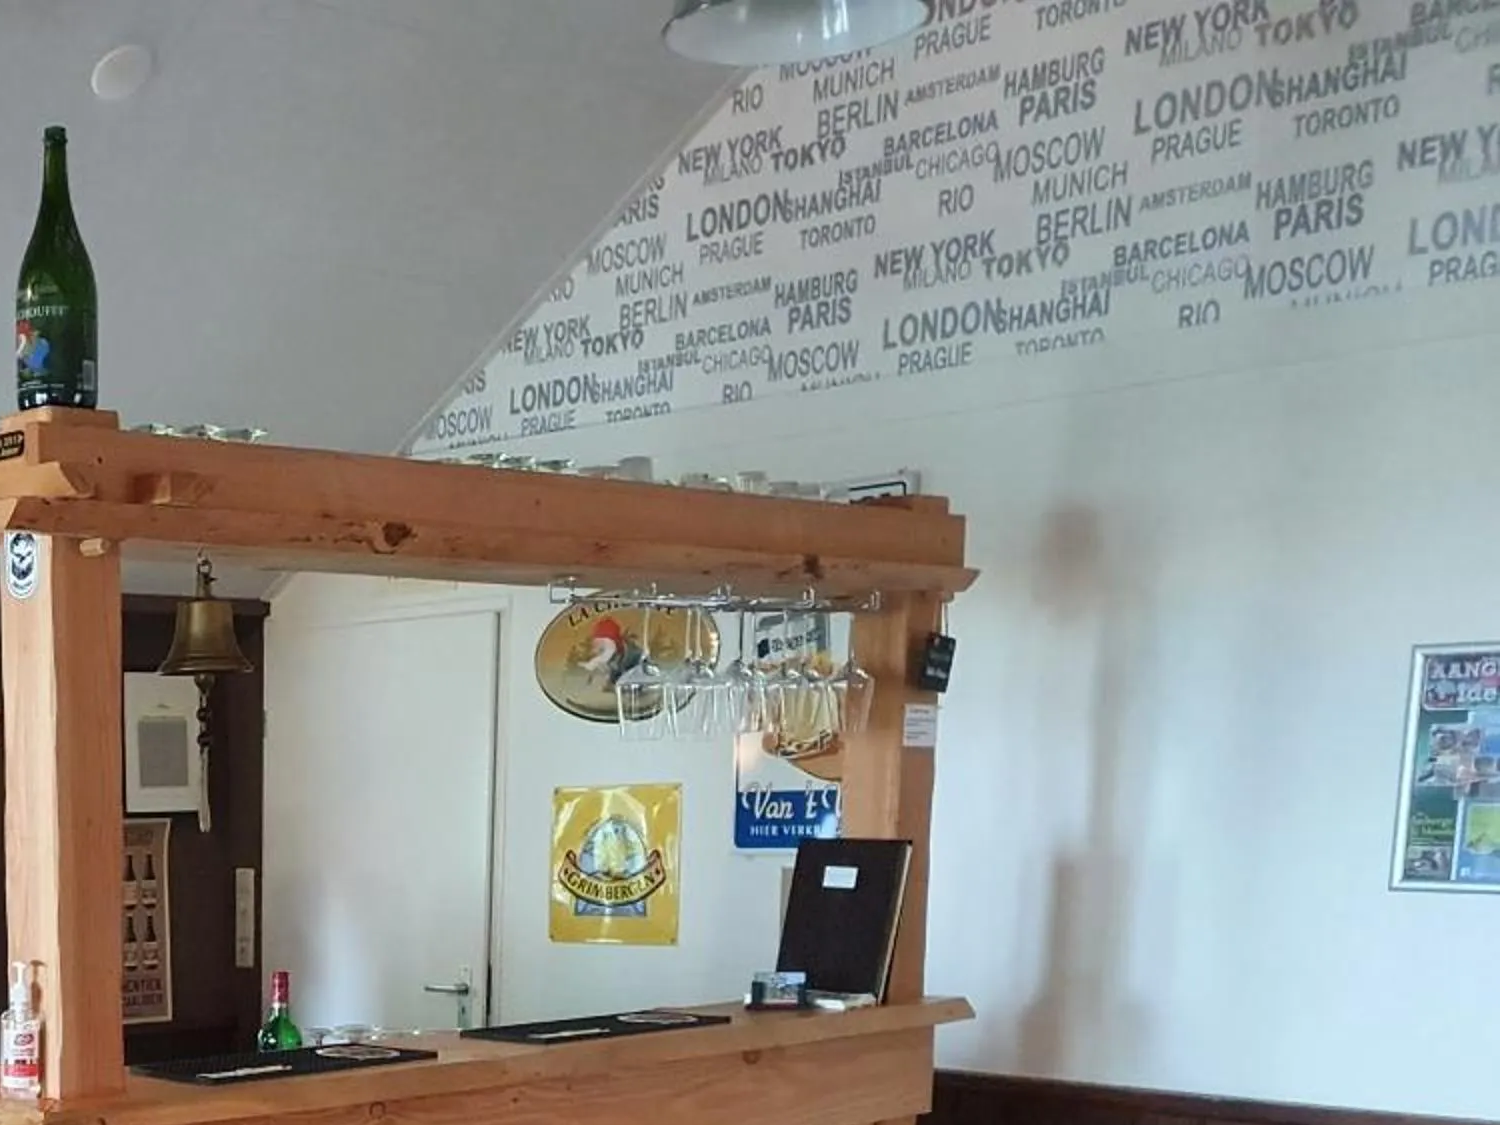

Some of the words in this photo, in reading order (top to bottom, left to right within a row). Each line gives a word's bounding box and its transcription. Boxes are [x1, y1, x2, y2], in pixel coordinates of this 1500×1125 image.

[914, 14, 992, 60] PRAGUE
[1125, 14, 1186, 56] NEW
[1194, 0, 1269, 32] YORK
[1255, 0, 1358, 47] TOKYO
[1159, 27, 1242, 67] MILANO
[813, 57, 895, 103] MUNICH
[904, 63, 1001, 106] AMSTERDAM
[1004, 46, 1104, 98] HAMBURG
[1270, 50, 1408, 108] SHANGHAI
[732, 84, 763, 115] RIO
[817, 89, 899, 138] BERLIN
[1019, 77, 1097, 127] PARIS
[1133, 67, 1280, 136] LONDON
[1293, 94, 1400, 140] TORONTO
[678, 142, 722, 175] NEW
[727, 126, 783, 158] YORK
[884, 110, 999, 157] BARCELONA
[993, 125, 1105, 183] MOSCOW
[1151, 118, 1242, 165] PRAGUE
[1397, 128, 1468, 172] NEW
[703, 155, 763, 186] MILANO
[770, 137, 847, 173] TOKYO
[916, 141, 999, 180] CHICAGO
[783, 179, 881, 223] SHANGHAI
[938, 184, 974, 218] RIO
[1033, 161, 1128, 206] MUNICH
[1139, 171, 1252, 213] AMSTERDAM
[1256, 159, 1373, 211] HAMBURG
[687, 188, 789, 242] LONDON
[799, 214, 876, 249] TORONTO
[1036, 195, 1132, 246] BERLIN
[1273, 193, 1364, 241] PARIS
[587, 232, 667, 275] MOSCOW
[700, 231, 763, 265] PRAGUE
[874, 244, 924, 279] NEW
[930, 229, 995, 264] YORK
[982, 240, 1070, 280] TOKYO
[1113, 220, 1250, 267] BARCELONA
[616, 262, 683, 297] MUNICH
[692, 277, 772, 306] AMSTERDAM
[775, 269, 858, 309] HAMBURG
[903, 259, 972, 290] MILANO
[1151, 253, 1249, 293] CHICAGO
[1244, 244, 1374, 299] MOSCOW
[544, 315, 590, 345] YORK
[620, 292, 688, 330] BERLIN
[788, 296, 852, 334] PARIS
[883, 297, 1002, 351] LONDON
[998, 288, 1111, 334] SHANGHAI
[1178, 300, 1220, 328] RIO
[580, 328, 644, 358] TOKYO
[675, 316, 771, 350] BARCELONA
[702, 345, 771, 375] CHICAGO
[768, 340, 859, 382] MOSCOW
[898, 342, 973, 376] PRAGUE
[510, 373, 597, 414] LONDON
[593, 371, 674, 404] SHANGHAI
[723, 381, 752, 404] RIO
[742, 781, 794, 819] Van
